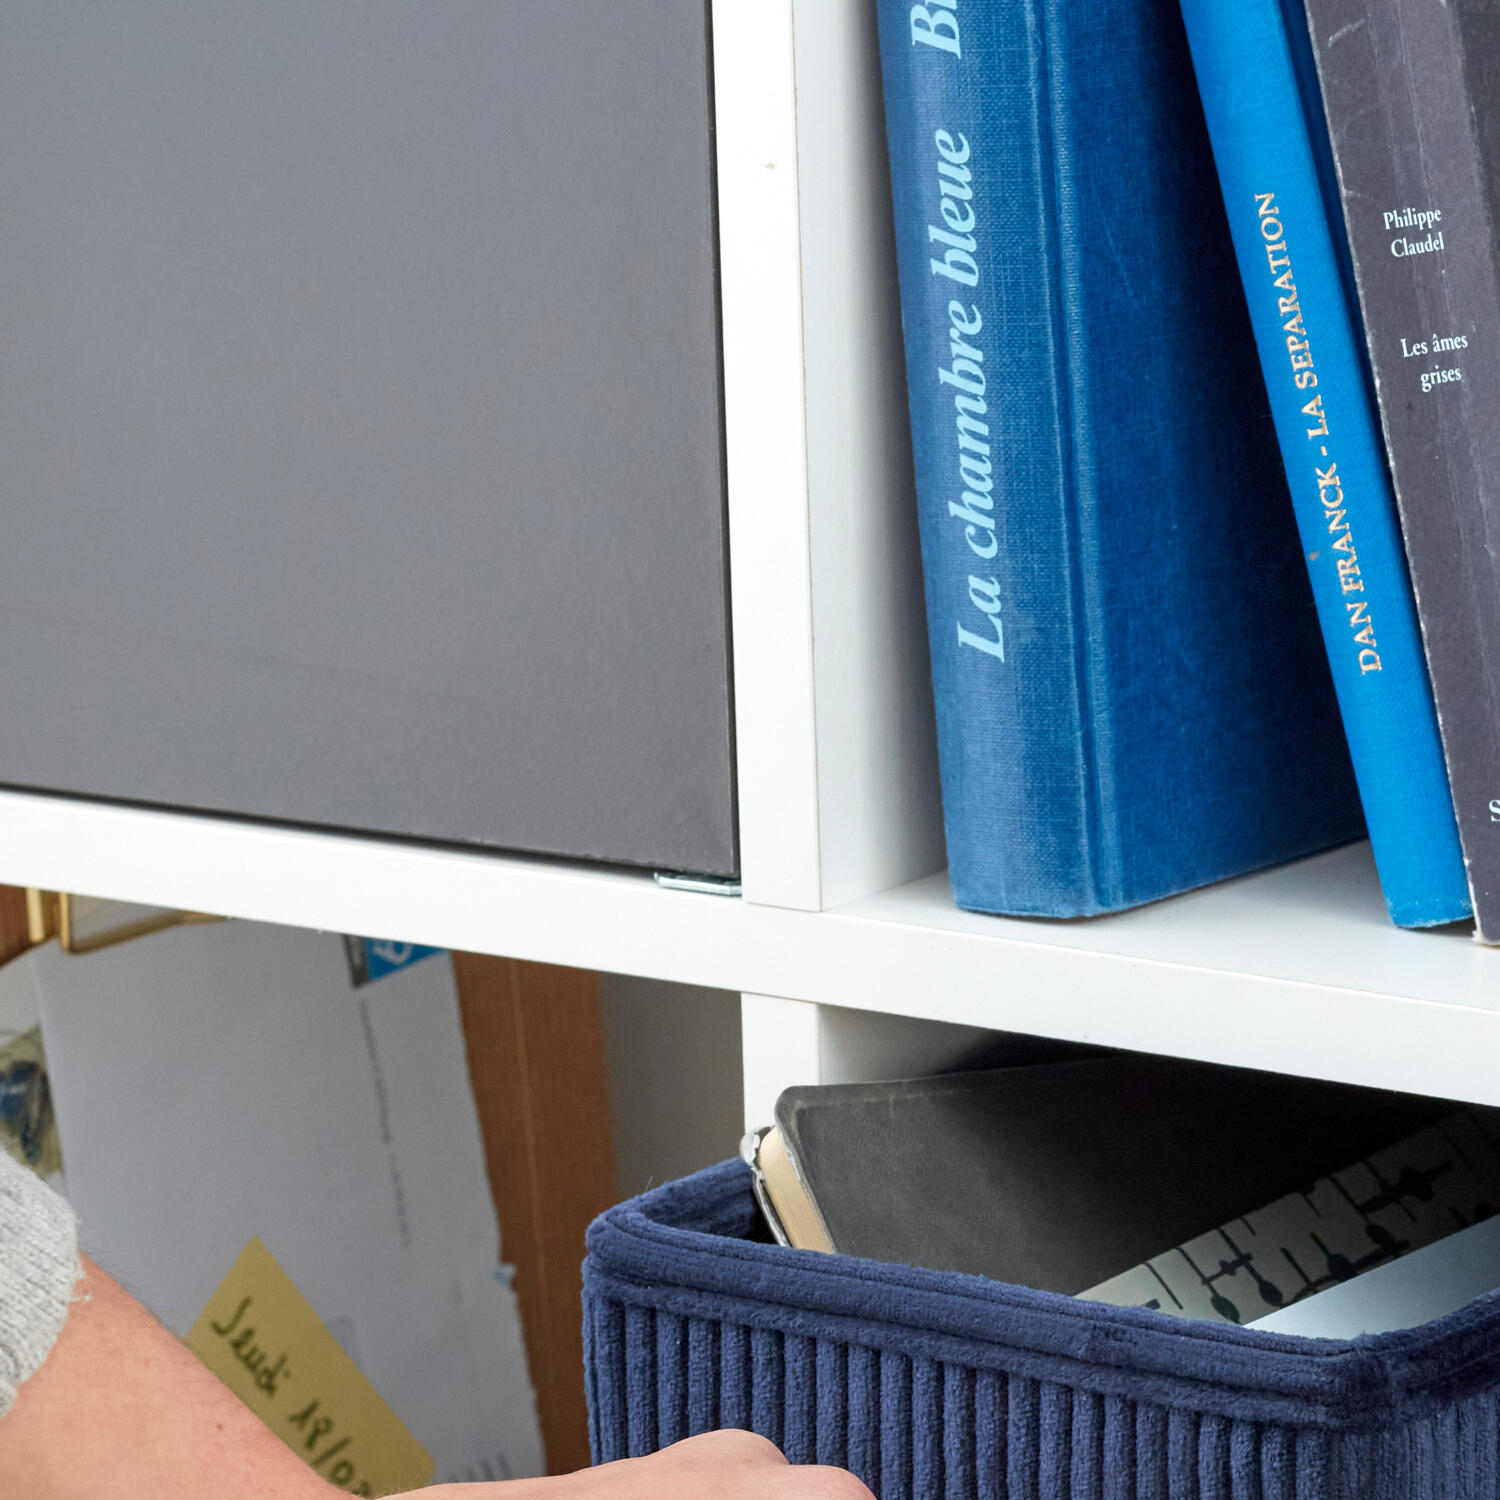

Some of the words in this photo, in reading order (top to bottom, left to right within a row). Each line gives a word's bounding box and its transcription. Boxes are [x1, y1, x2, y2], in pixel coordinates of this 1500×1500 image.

[911, 0, 961, 60] B
[927, 129, 979, 287] bleue
[1383, 207, 1442, 231] Philippe
[1390, 231, 1445, 258] Claudel
[1255, 192, 1319, 390] SEPARATION
[1400, 337, 1428, 358] Les
[1432, 333, 1469, 354] âmes
[1420, 364, 1462, 393] grises
[937, 300, 999, 559] chambre
[1302, 394, 1329, 440] LA
[1315, 462, 1365, 596] FRANCK
[957, 575, 1005, 663] La
[1347, 601, 1383, 675] DAN
